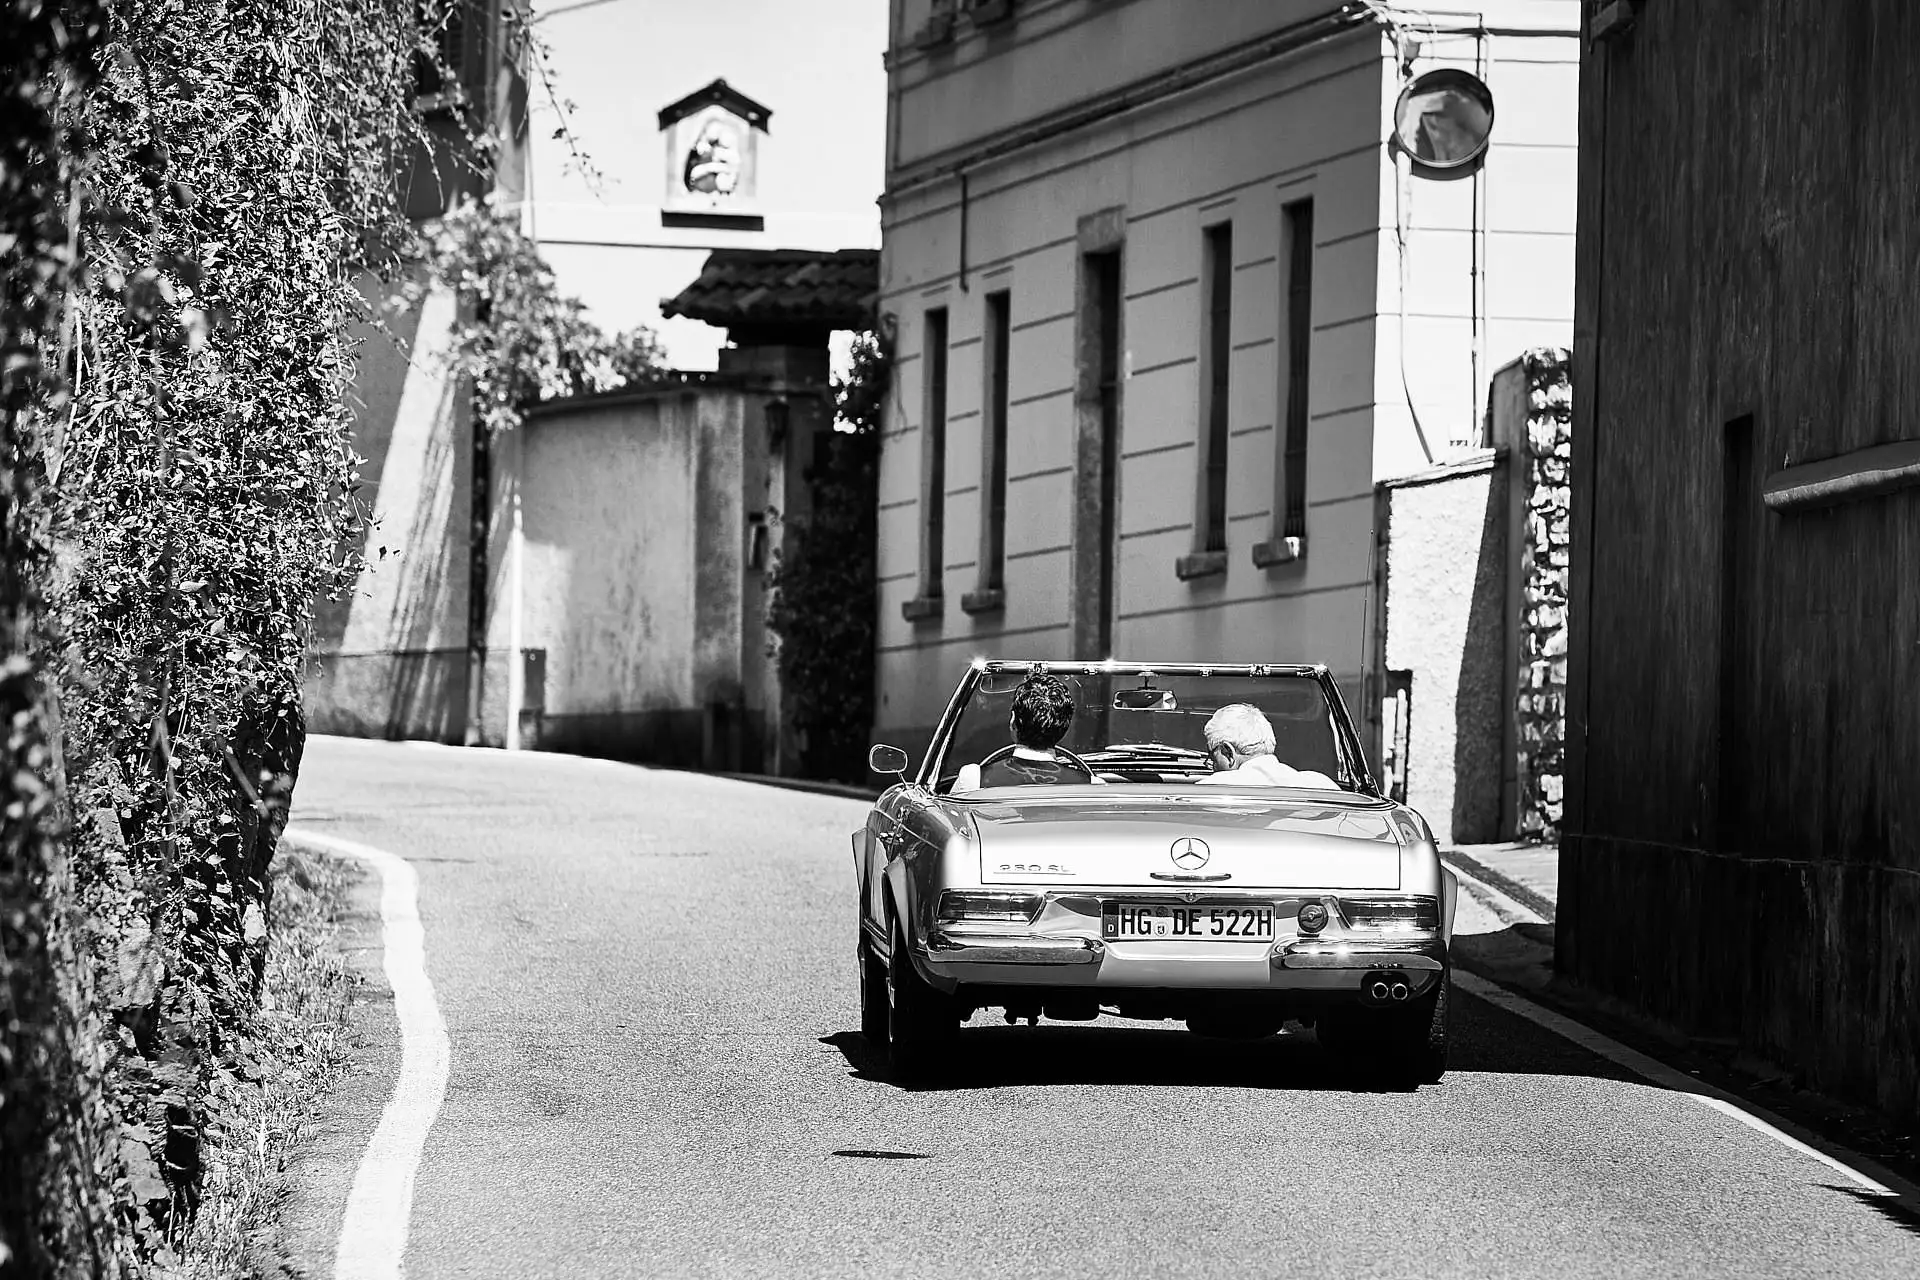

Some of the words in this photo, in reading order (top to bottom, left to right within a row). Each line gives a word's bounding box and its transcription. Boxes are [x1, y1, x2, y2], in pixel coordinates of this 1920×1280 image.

[1121, 908, 1151, 935] HG
[1172, 908, 1202, 935] DE
[1210, 909, 1272, 936] 522H
